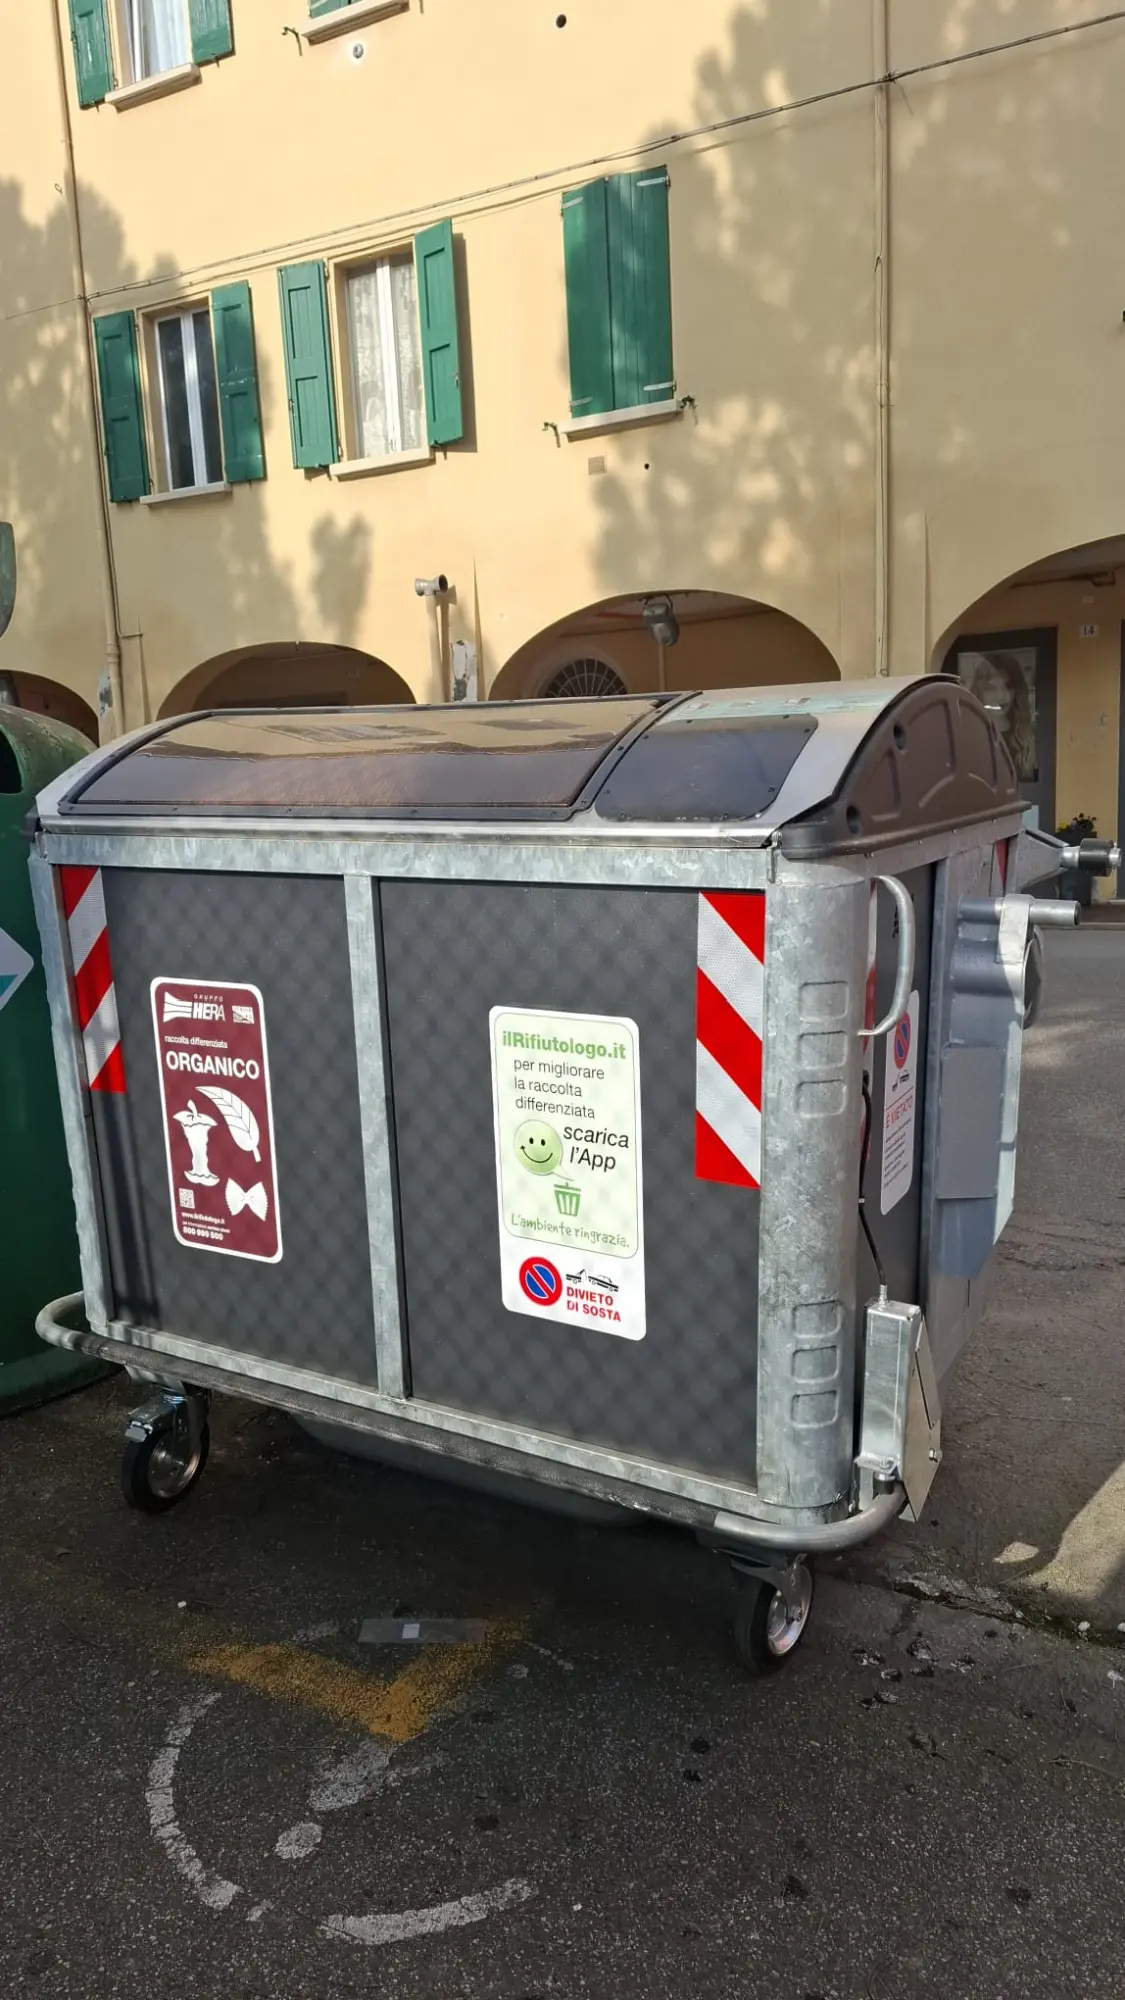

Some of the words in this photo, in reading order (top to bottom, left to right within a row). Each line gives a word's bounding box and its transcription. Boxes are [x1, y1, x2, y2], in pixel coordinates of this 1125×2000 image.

[1084, 625, 1094, 636] 14
[193, 993, 224, 1002] GRUPPO
[192, 1002, 226, 1022] HERA
[164, 1035, 189, 1045] raccolta
[190, 1036, 228, 1049] differenziata
[501, 1030, 627, 1060] ilRifiutologo.it
[165, 1050, 260, 1080] ORGANICO
[513, 1059, 536, 1074] per
[538, 1062, 605, 1080] migliorare
[514, 1076, 526, 1090] la
[528, 1080, 583, 1098] raccolta
[515, 1096, 596, 1119] differenziata
[890, 1095, 913, 1125] VIETATO
[563, 1125, 629, 1149] scarica
[569, 1146, 617, 1173] l'App
[183, 1226, 196, 1236] 800
[196, 1228, 210, 1238] 999
[210, 1231, 224, 1241] 500
[510, 1213, 572, 1237] L'ambiente
[574, 1227, 630, 1249] ringrazia.
[566, 1286, 614, 1306] DIVIETO
[566, 1300, 579, 1313] DI
[582, 1303, 621, 1322] SOSTA
